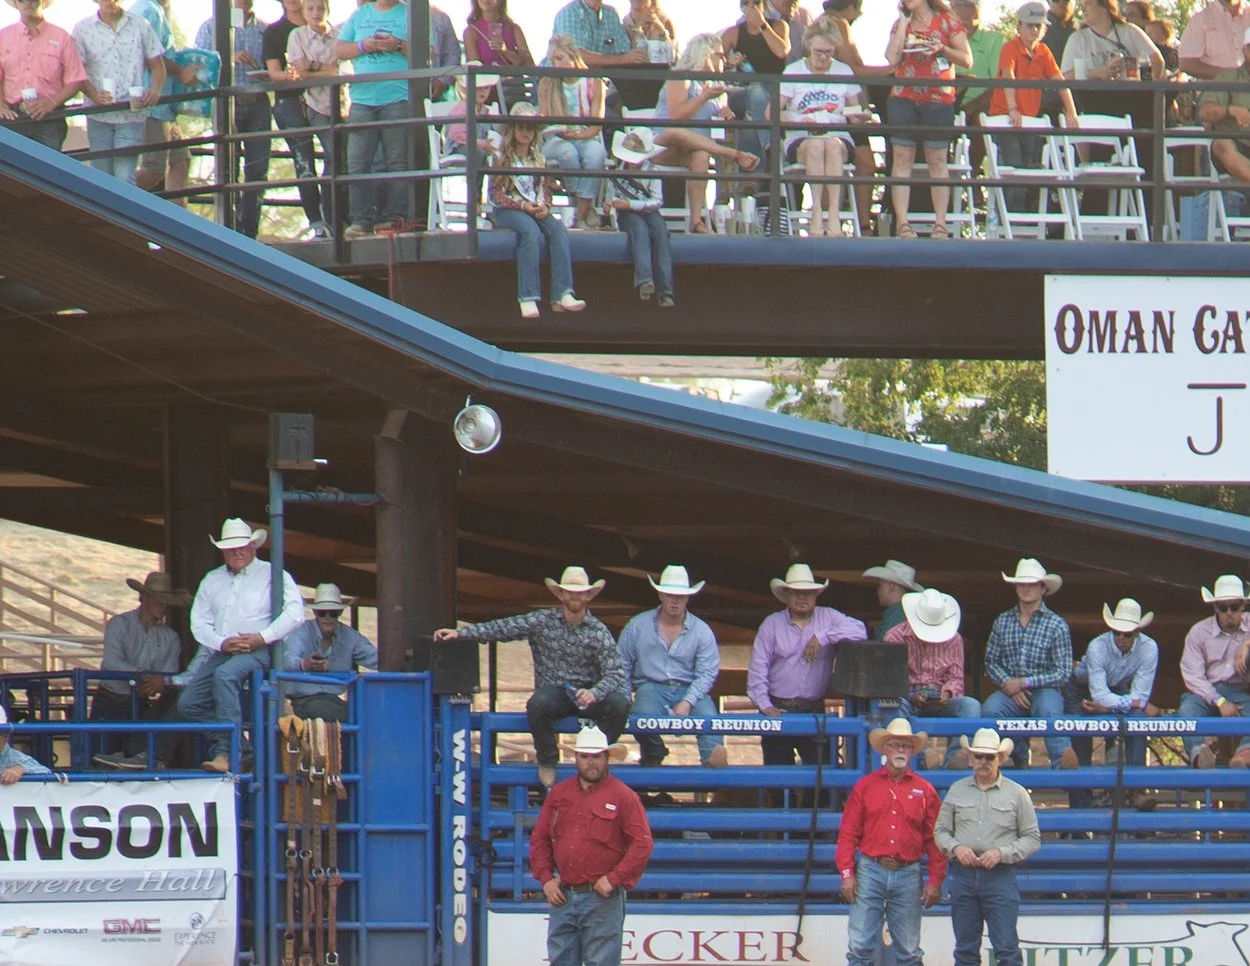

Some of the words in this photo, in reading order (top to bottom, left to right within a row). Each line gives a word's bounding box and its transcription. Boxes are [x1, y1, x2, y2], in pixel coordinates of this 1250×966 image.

[1053, 303, 1176, 355] OMAN
[636, 717, 706, 731] COWBOY
[711, 718, 783, 731] REUNION
[996, 719, 1048, 731] TEXAS
[1054, 719, 1120, 732] COWBOY
[1127, 720, 1198, 732] REUNION
[0, 801, 220, 862] NSON
[134, 868, 216, 893] Hall
[452, 815, 467, 944] RODEO
[43, 927, 89, 935] CHEVROLET
[102, 918, 162, 935] GMC
[543, 917, 811, 962] ECKER
